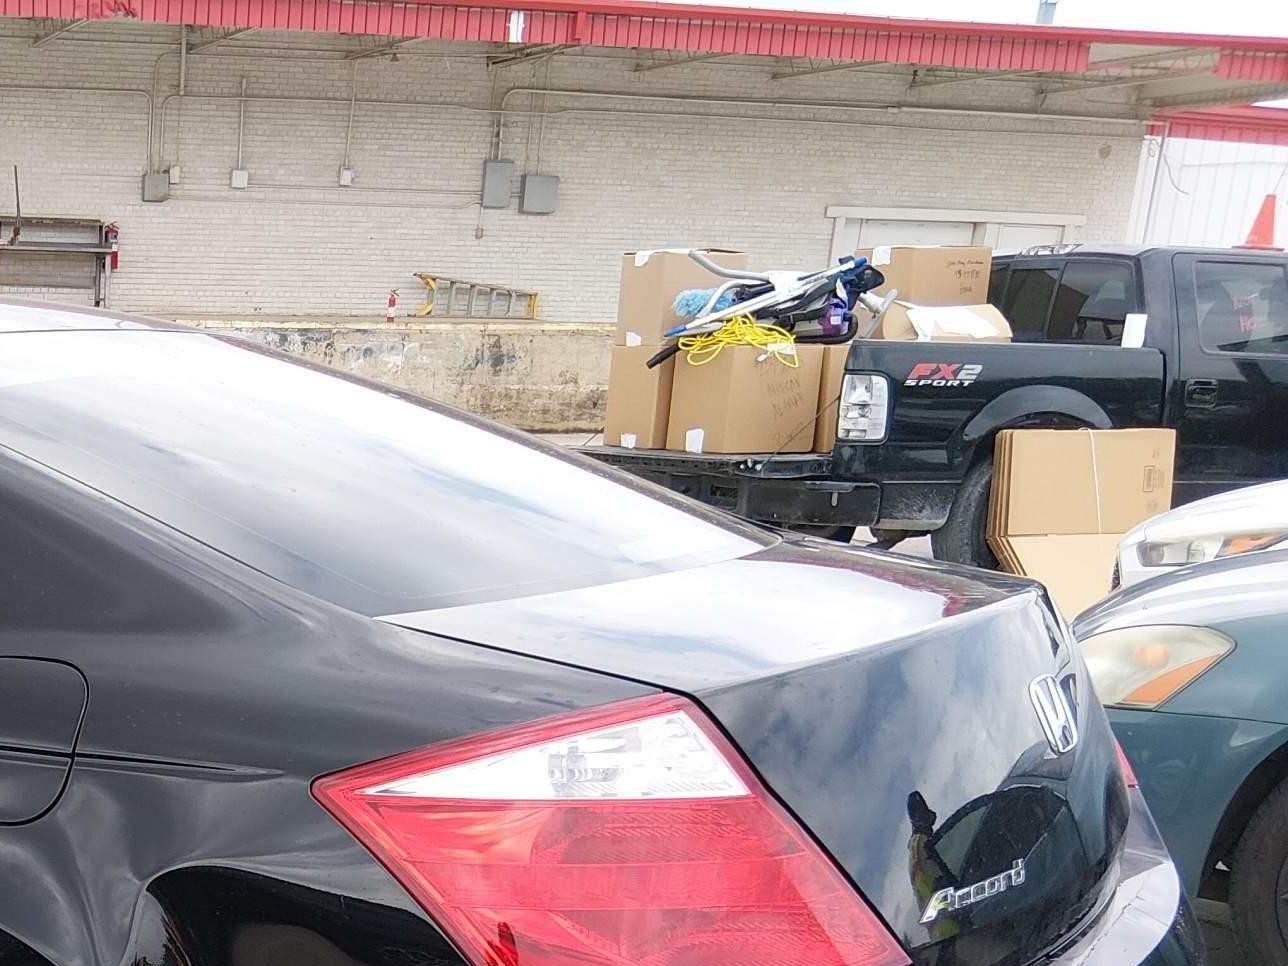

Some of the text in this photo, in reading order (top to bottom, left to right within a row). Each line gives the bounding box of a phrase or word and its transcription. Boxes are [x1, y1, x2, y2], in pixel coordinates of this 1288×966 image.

[907, 362, 984, 380] FX2
[903, 379, 974, 387] SPORT
[919, 858, 1025, 924] Accord
